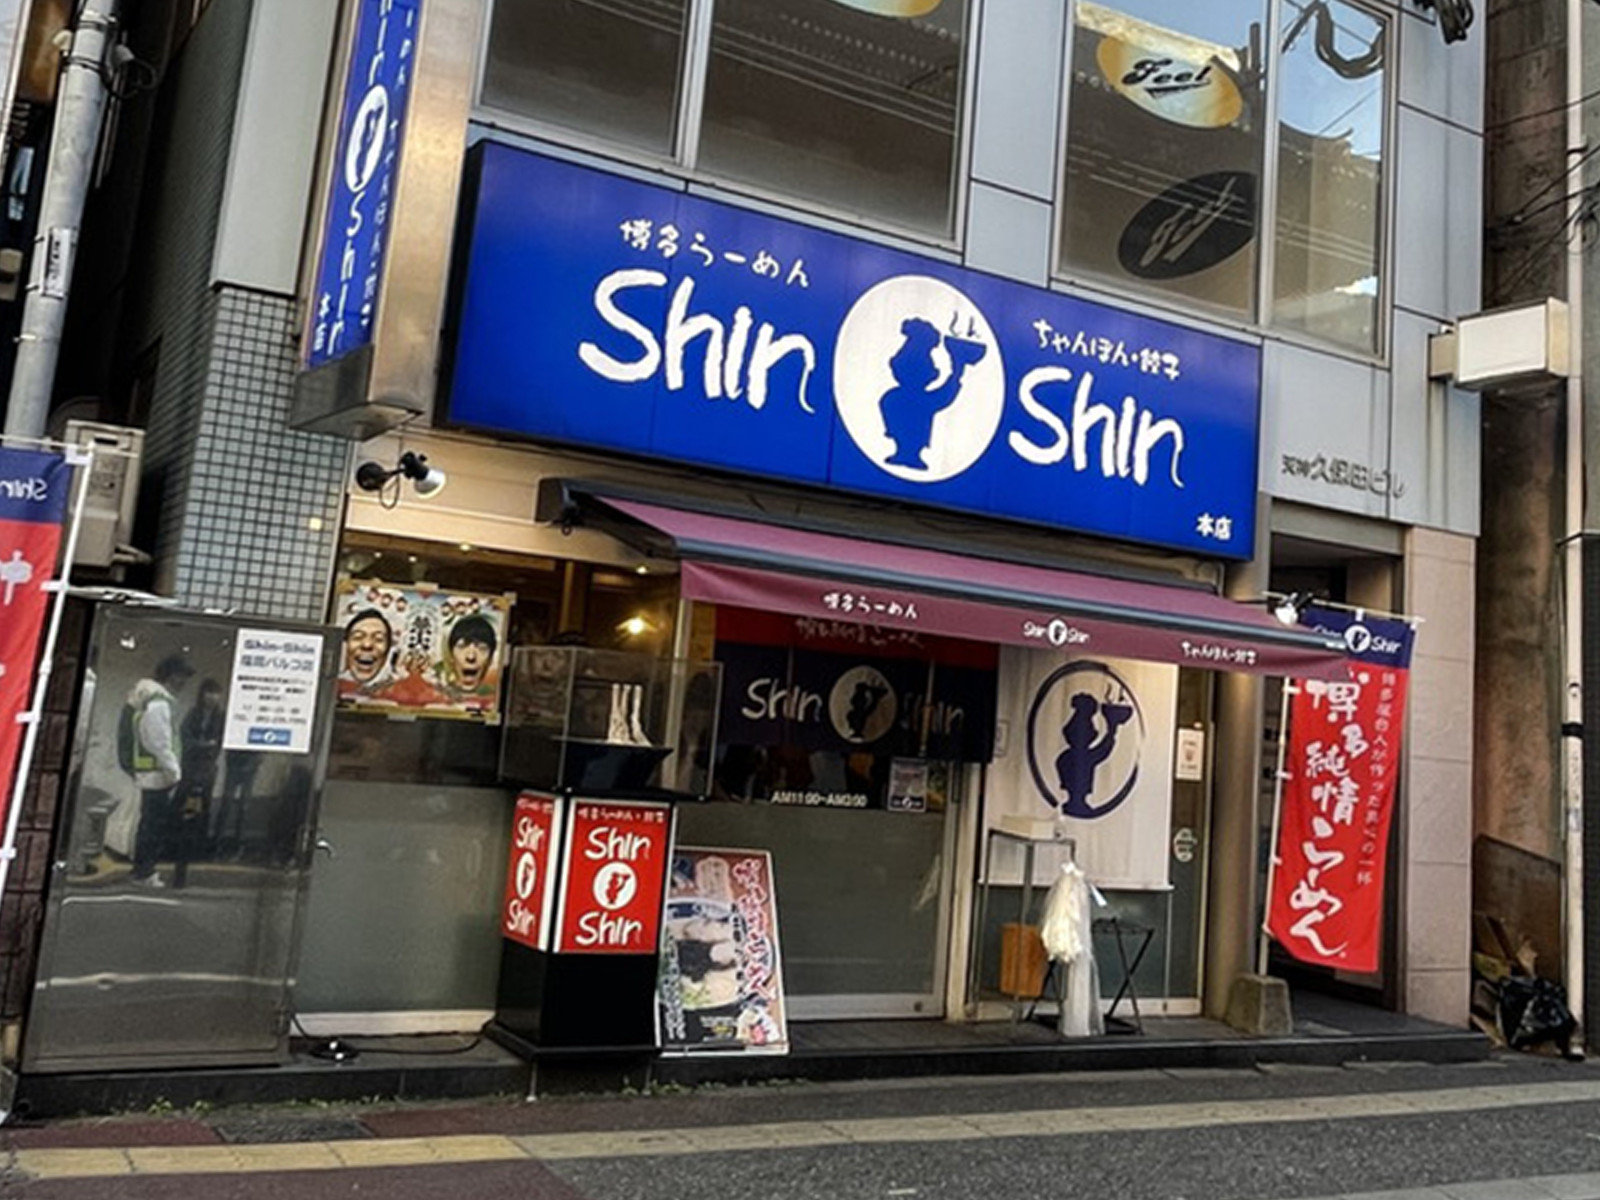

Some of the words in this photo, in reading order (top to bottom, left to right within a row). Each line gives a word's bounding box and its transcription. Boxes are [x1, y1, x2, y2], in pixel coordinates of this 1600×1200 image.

[1122, 58, 1212, 85] Feel
[619, 219, 809, 288] 博多らーめん
[578, 268, 815, 414] Shin
[1008, 365, 1184, 488] Shin
[1195, 513, 1232, 540] 本店
[823, 592, 918, 619] 博多らーめん
[741, 677, 823, 722] Shin
[584, 826, 652, 861] Shin
[575, 911, 643, 946] Shin
